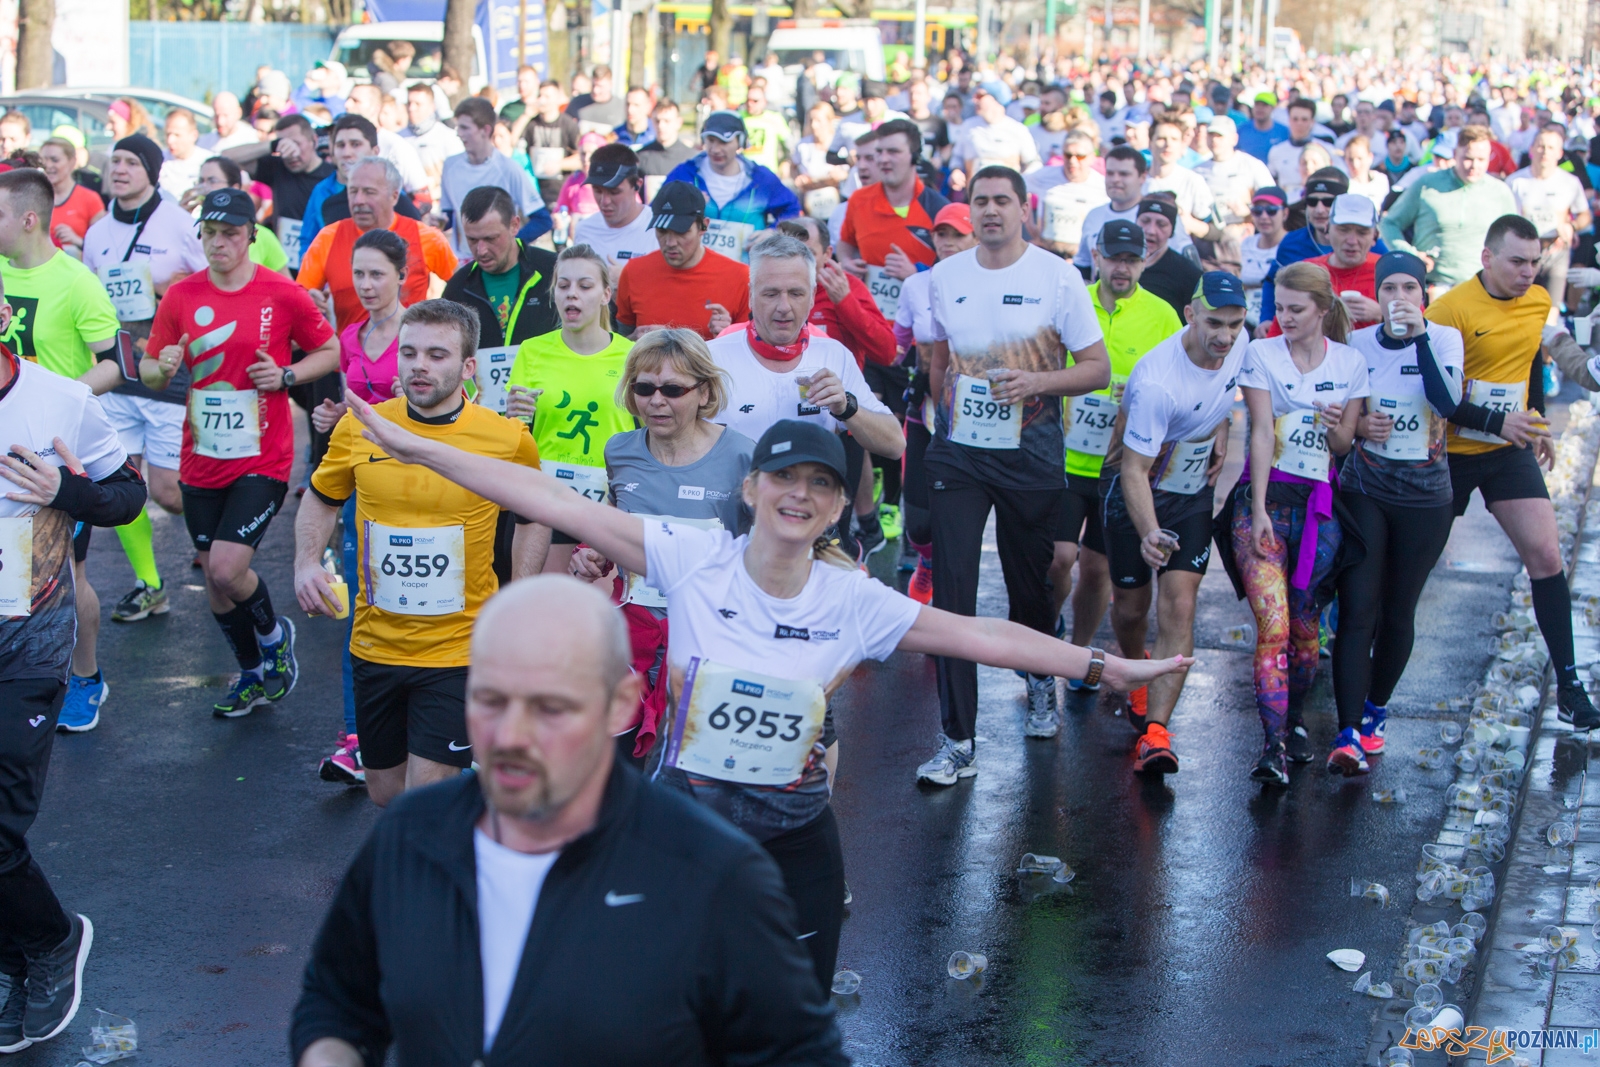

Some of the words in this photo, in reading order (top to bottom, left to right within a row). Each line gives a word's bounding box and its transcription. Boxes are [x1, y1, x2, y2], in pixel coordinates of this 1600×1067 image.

[702, 232, 735, 248] 8738
[106, 279, 142, 298] 5372
[739, 404, 755, 414] 4F
[962, 398, 1011, 421] 5398
[202, 411, 244, 430] 7712
[624, 483, 639, 492] 4F
[381, 553, 450, 578] 6359
[401, 580, 428, 589] Kacper
[718, 608, 738, 619] 4F
[734, 683, 763, 696] 10.PKO
[708, 702, 804, 742] 6953
[729, 737, 773, 752] Marzena
